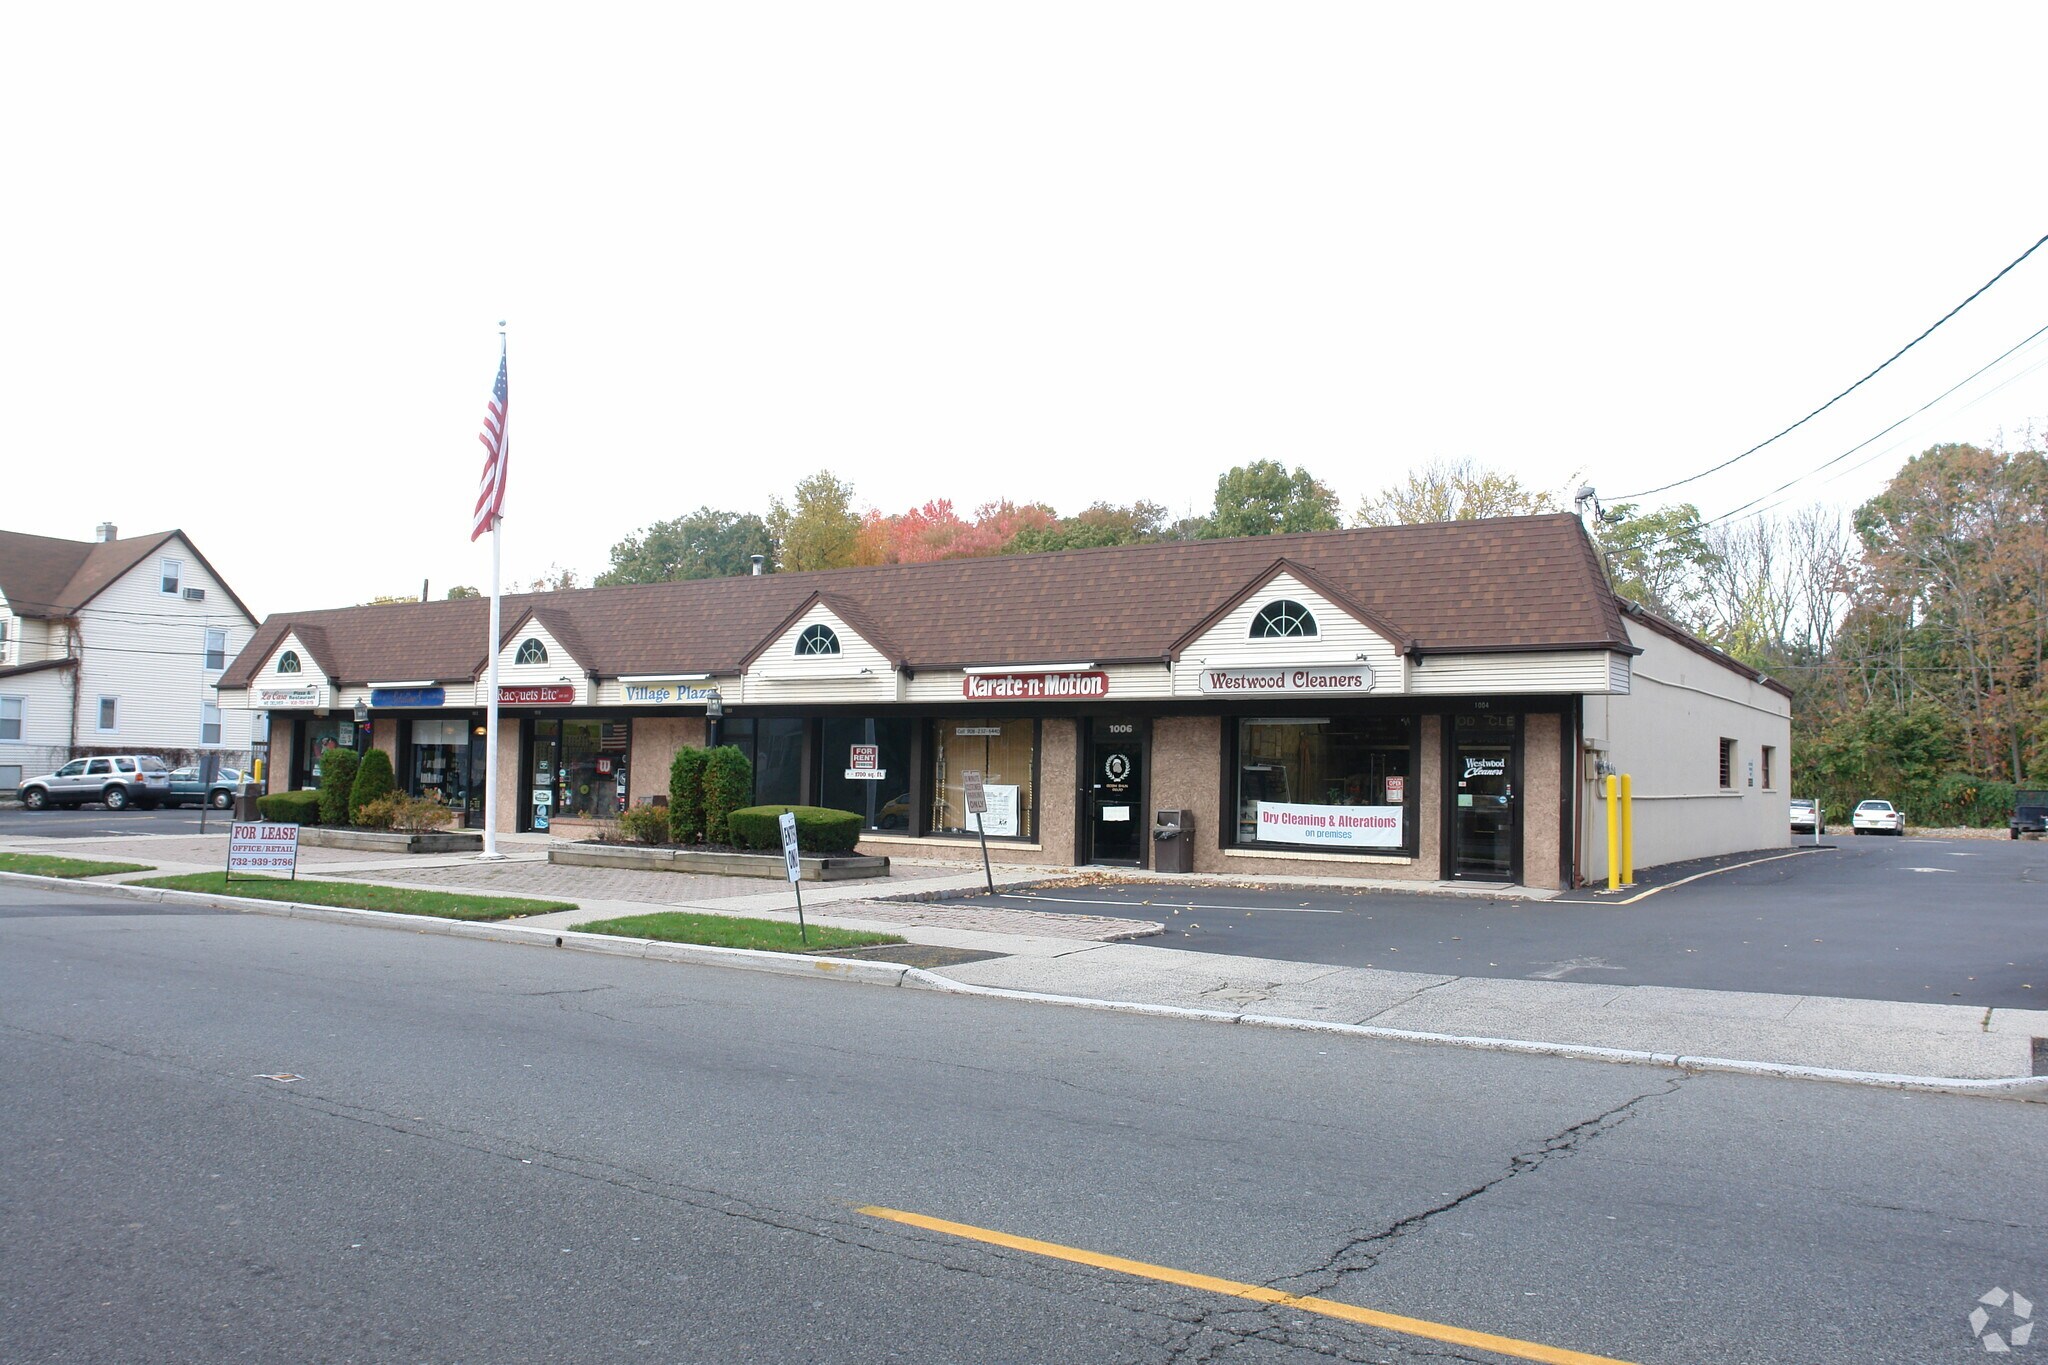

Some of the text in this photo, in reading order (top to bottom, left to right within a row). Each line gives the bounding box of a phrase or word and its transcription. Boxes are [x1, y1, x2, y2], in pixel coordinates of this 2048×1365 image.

[1210, 671, 1362, 689] Westwood Cleaners
[626, 685, 670, 703] Village
[1109, 725, 1133, 733] 1006
[1466, 758, 1505, 768] Westwood
[1464, 767, 1503, 779] Cleaners
[970, 800, 984, 809] ONLY
[1263, 811, 1397, 828] Dry Cleaning & Alterations
[234, 826, 296, 840] FOR LEASE
[1305, 829, 1352, 839] on premises
[231, 858, 293, 866] 732-939-3786
